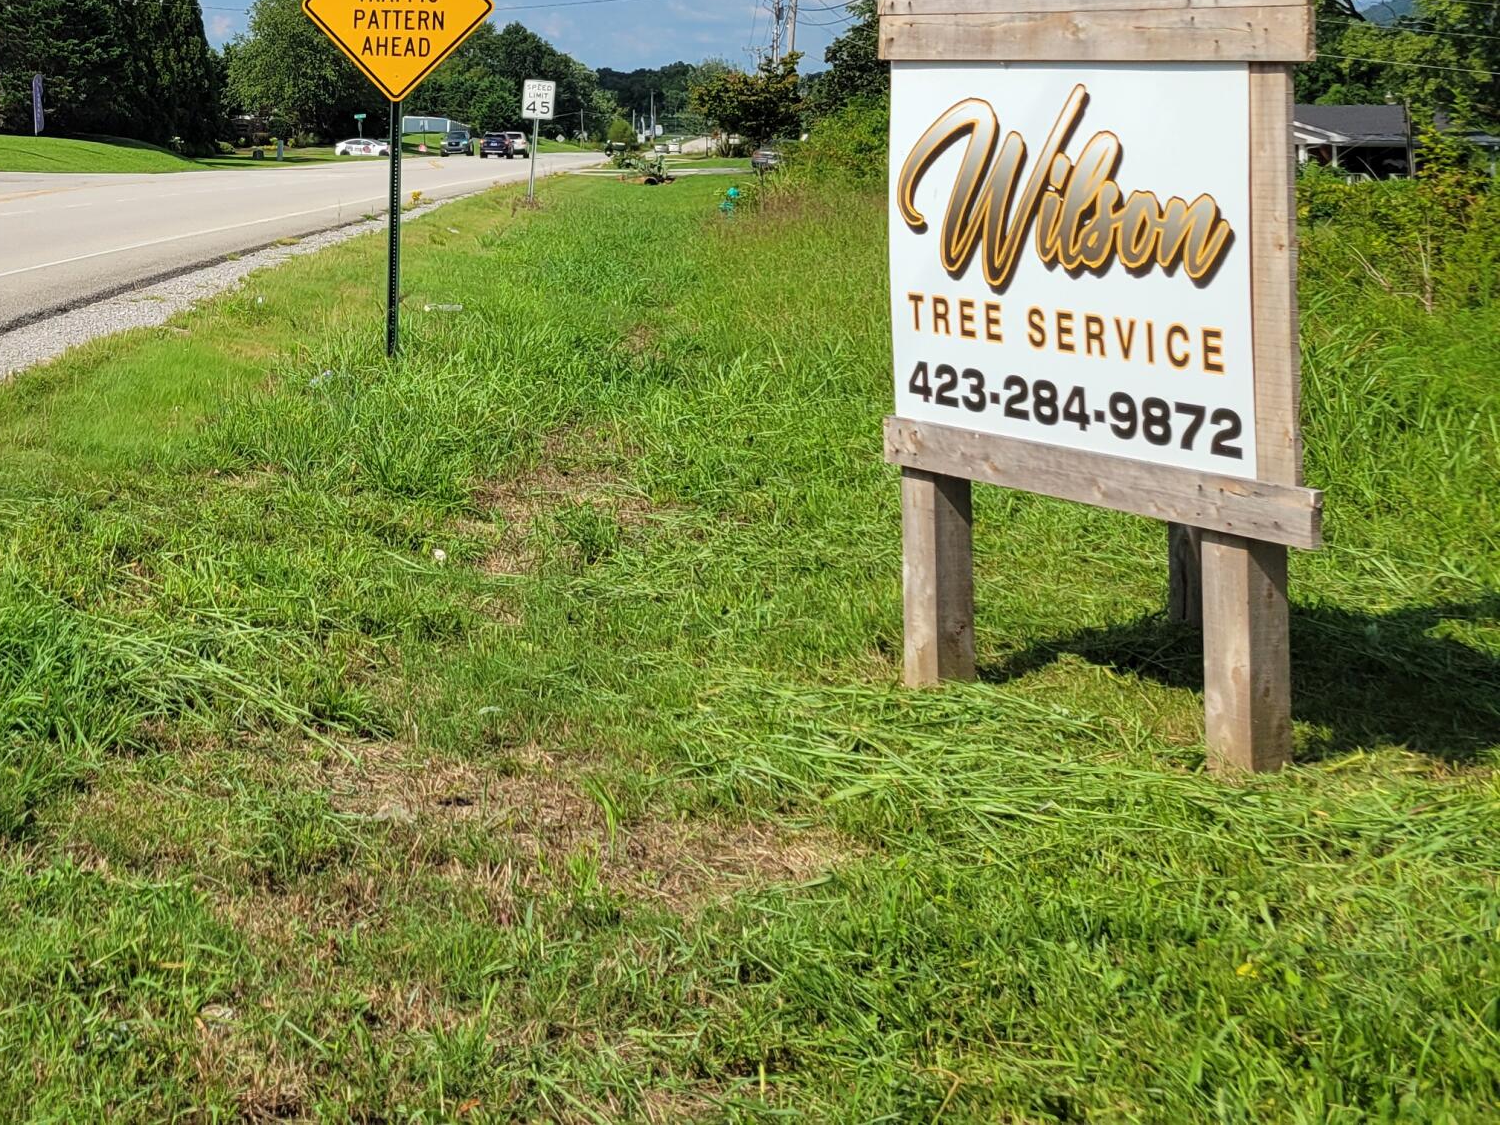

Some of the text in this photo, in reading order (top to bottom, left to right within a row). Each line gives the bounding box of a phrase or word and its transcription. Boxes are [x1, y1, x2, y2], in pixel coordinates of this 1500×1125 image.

[354, 9, 444, 30] PATTERN
[361, 36, 431, 57] AHEAD
[526, 101, 550, 114] 45
[897, 84, 1235, 294] Wilson
[908, 291, 1227, 376] TREE SERVICE
[909, 361, 1244, 461] 423-284-9872
